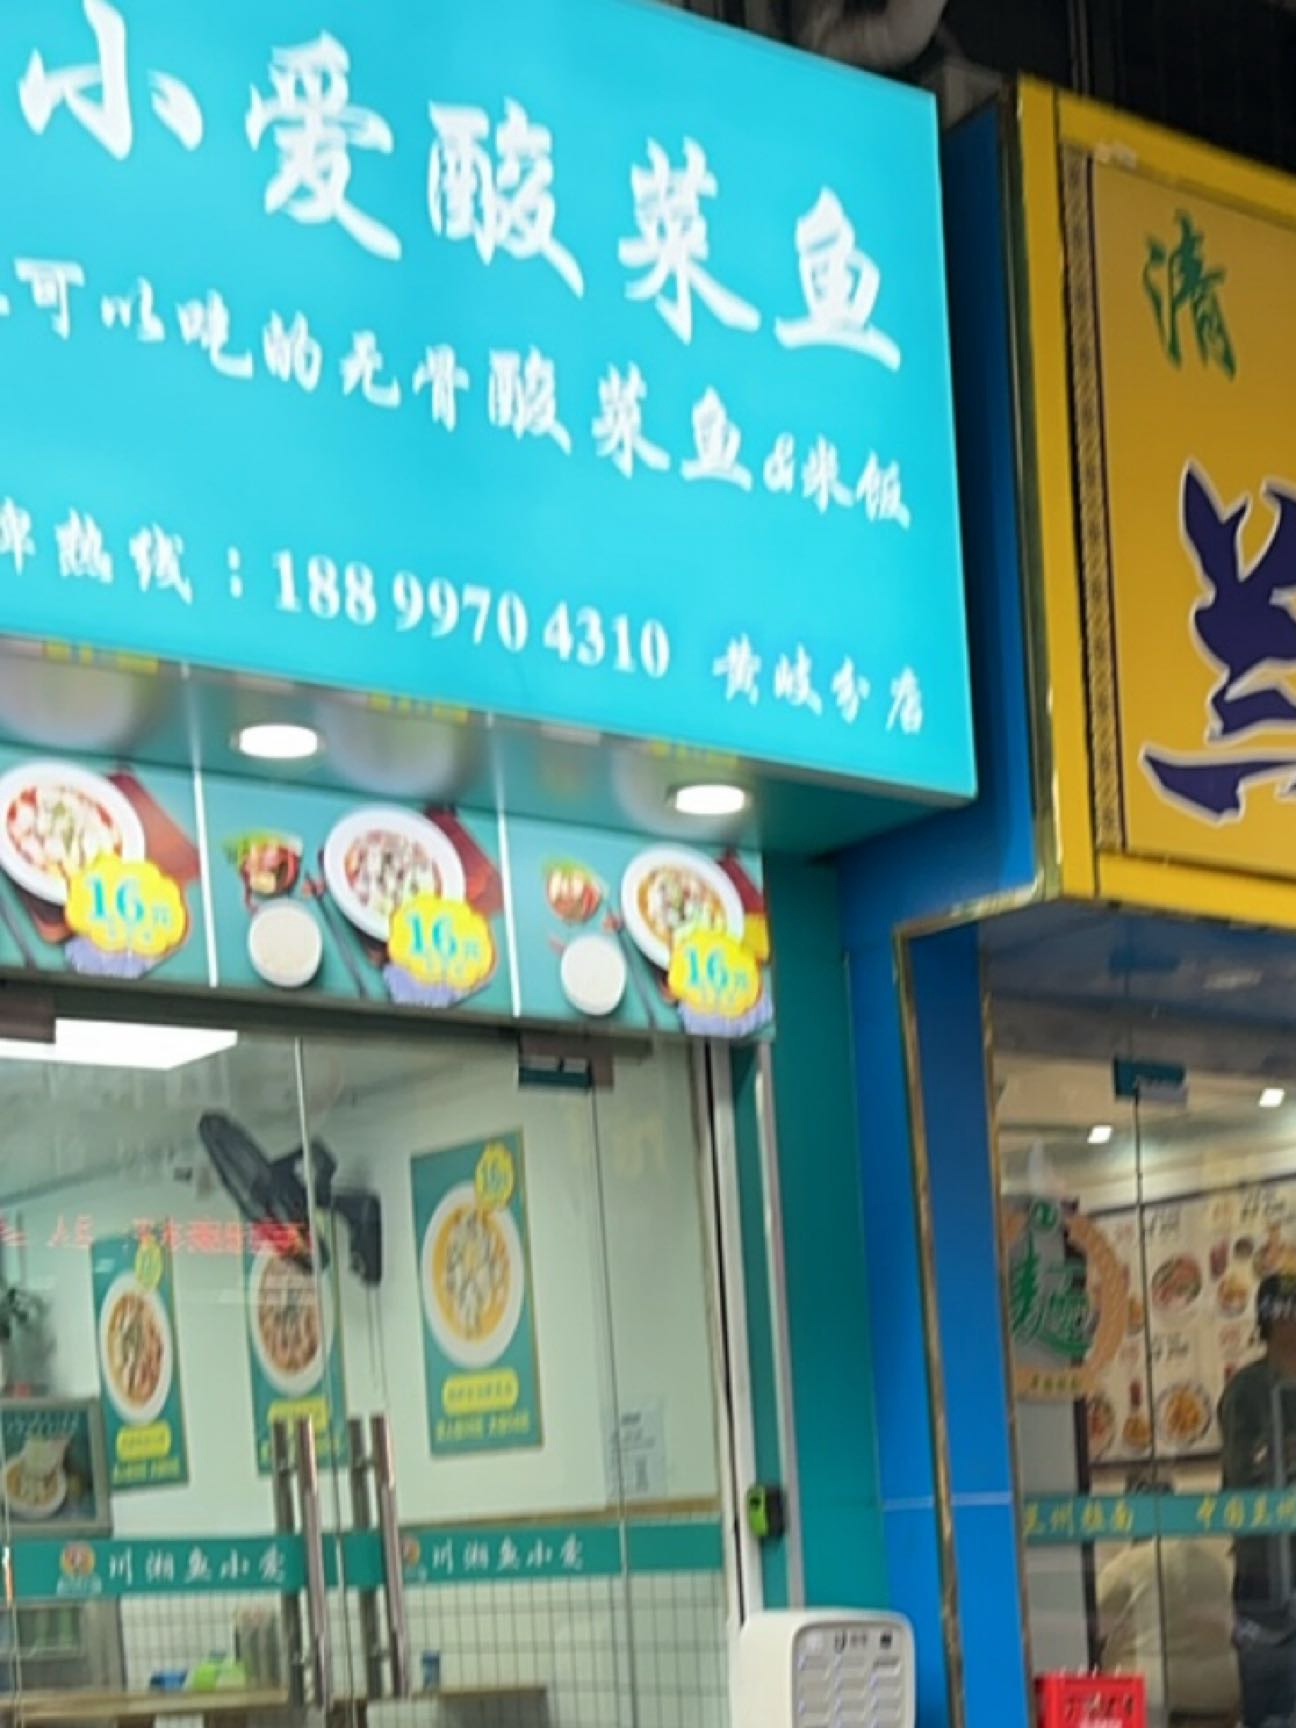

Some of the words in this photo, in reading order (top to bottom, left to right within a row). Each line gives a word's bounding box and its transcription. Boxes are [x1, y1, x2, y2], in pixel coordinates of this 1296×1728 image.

[19, 0, 902, 371] 小爱酸菜鱼
[1141, 209, 1237, 381] 清
[0, 258, 911, 528] 可以吃的无骨酸菜鱼&米饭
